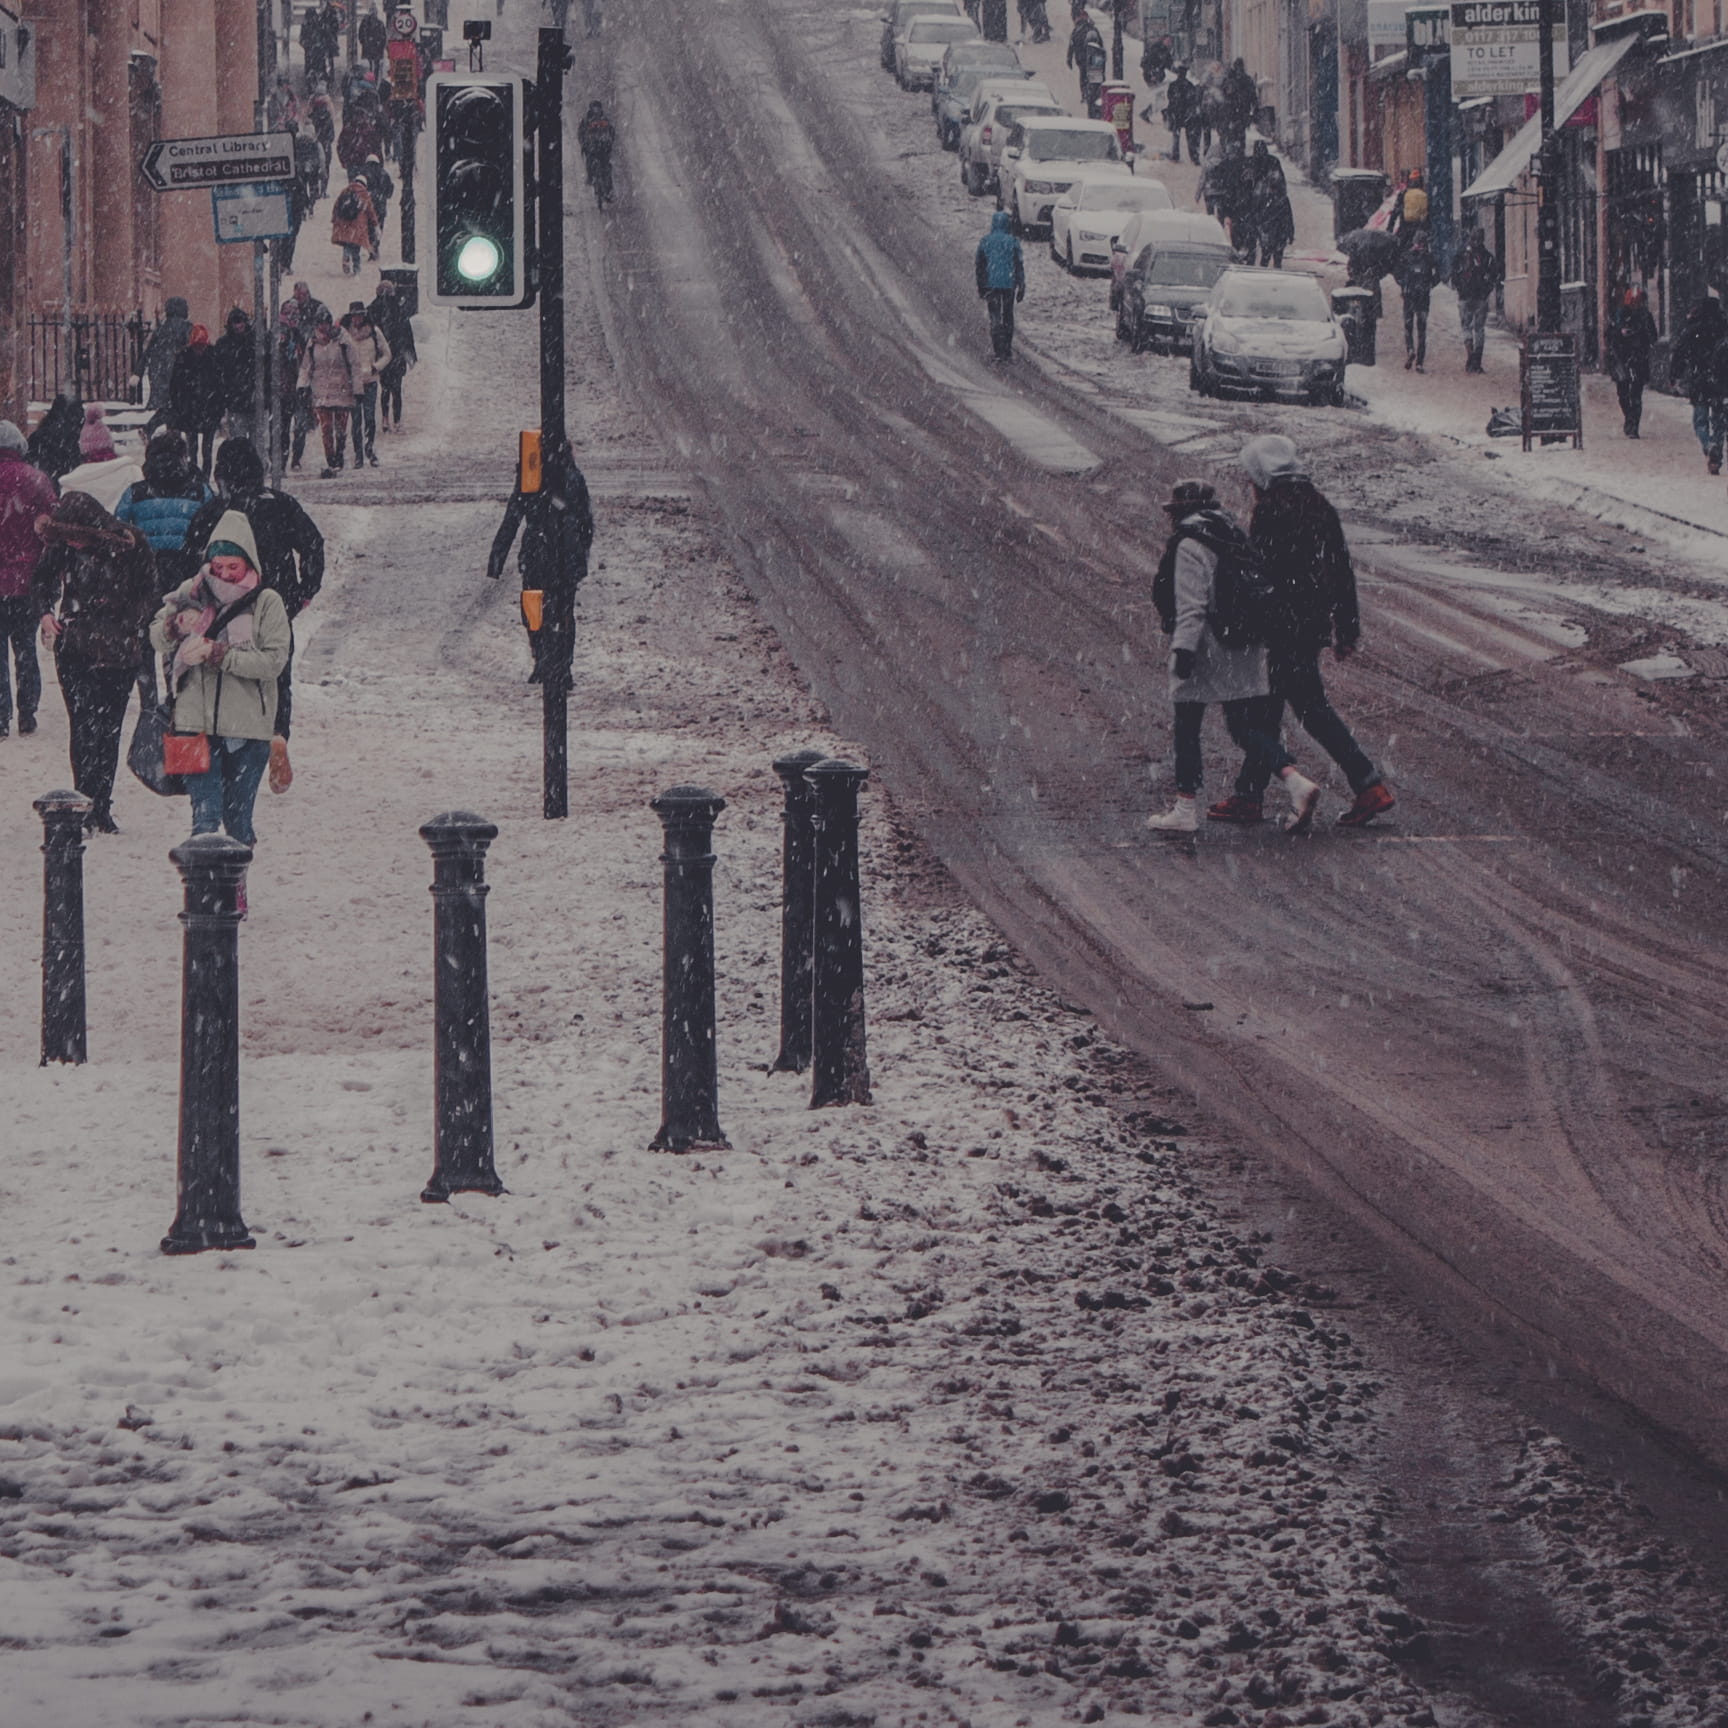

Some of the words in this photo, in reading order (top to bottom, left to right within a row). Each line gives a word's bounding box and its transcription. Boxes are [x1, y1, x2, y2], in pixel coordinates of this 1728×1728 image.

[1465, 4, 1509, 23] alder
[1513, 2, 1540, 20] kin
[396, 19, 413, 29] 20
[1465, 30, 1492, 43] 0117
[1467, 47, 1485, 59] TO
[1489, 46, 1515, 58] LET
[169, 144, 218, 157] Central
[222, 141, 268, 154] Library
[173, 167, 217, 178] Bristol
[222, 160, 289, 176] Cathedral
